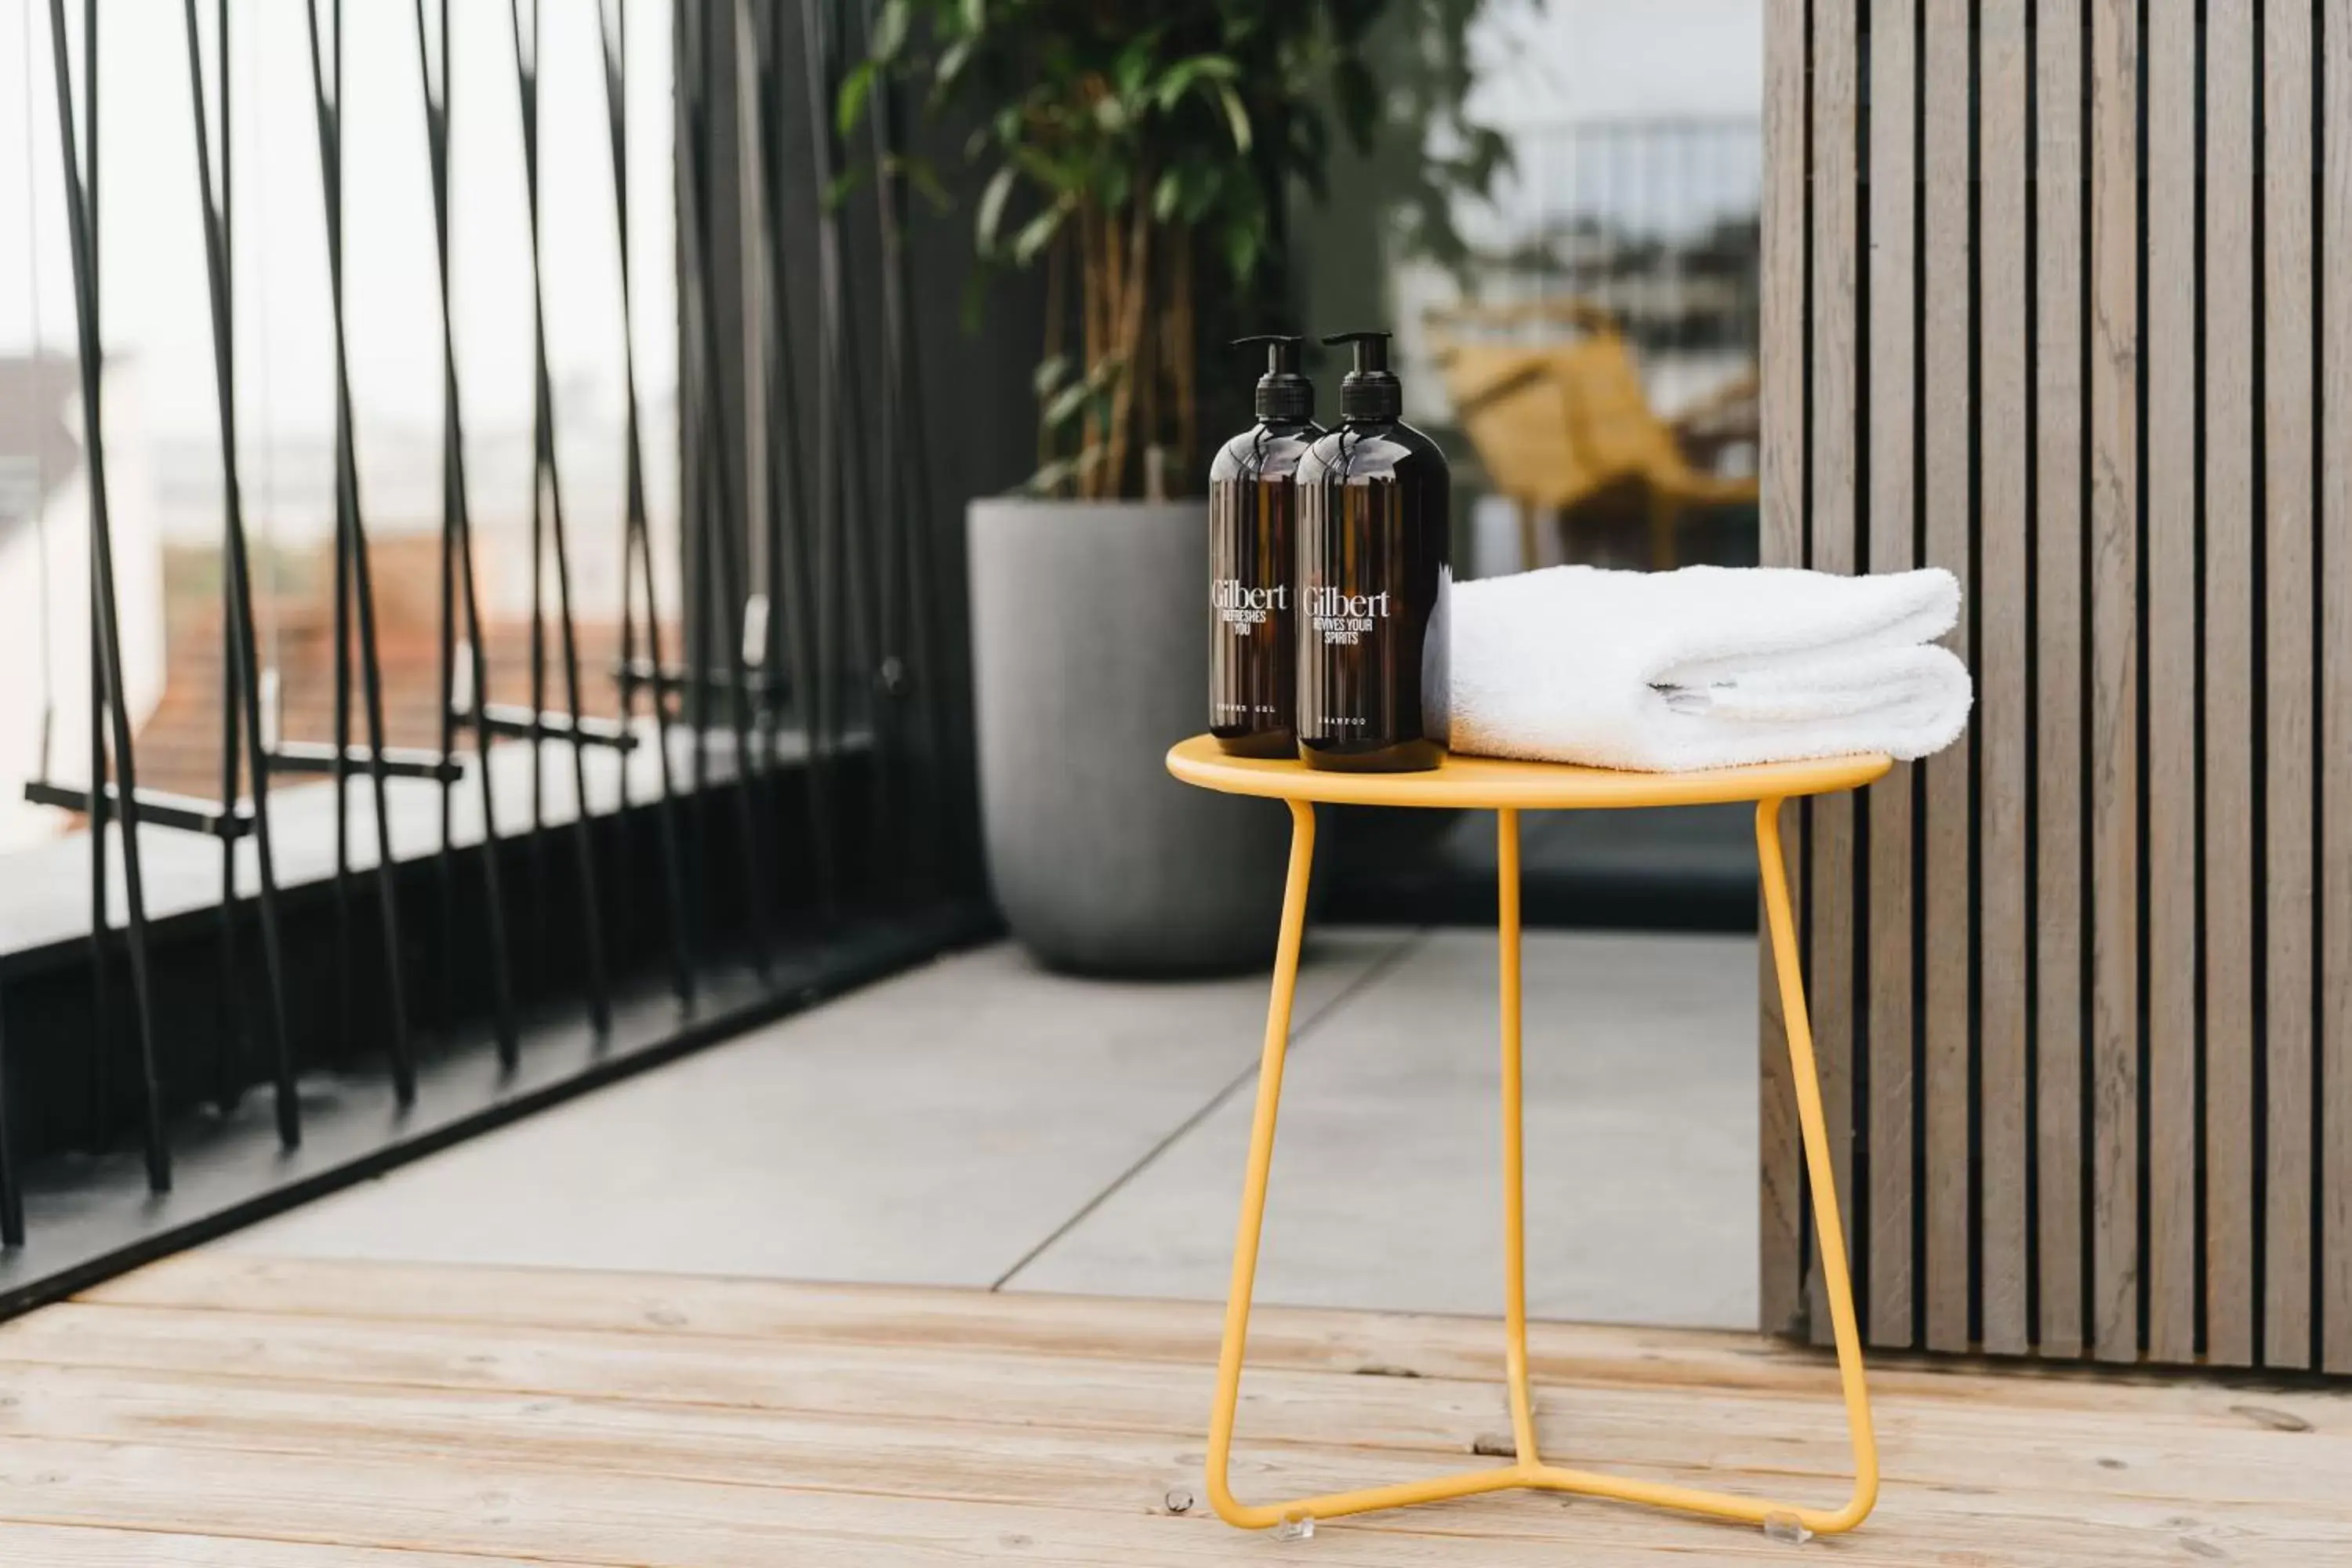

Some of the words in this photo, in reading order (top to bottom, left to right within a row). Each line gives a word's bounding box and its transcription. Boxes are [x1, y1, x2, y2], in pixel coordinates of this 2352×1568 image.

[1212, 579, 1287, 609] Gilbert
[1303, 586, 1391, 618] Gilbert
[1223, 610, 1266, 622] REFRESHES
[1236, 622, 1250, 635] YOU
[1314, 618, 1345, 631] REVIVES
[1346, 618, 1373, 632] YOUR
[1324, 632, 1359, 645] SPIRITS
